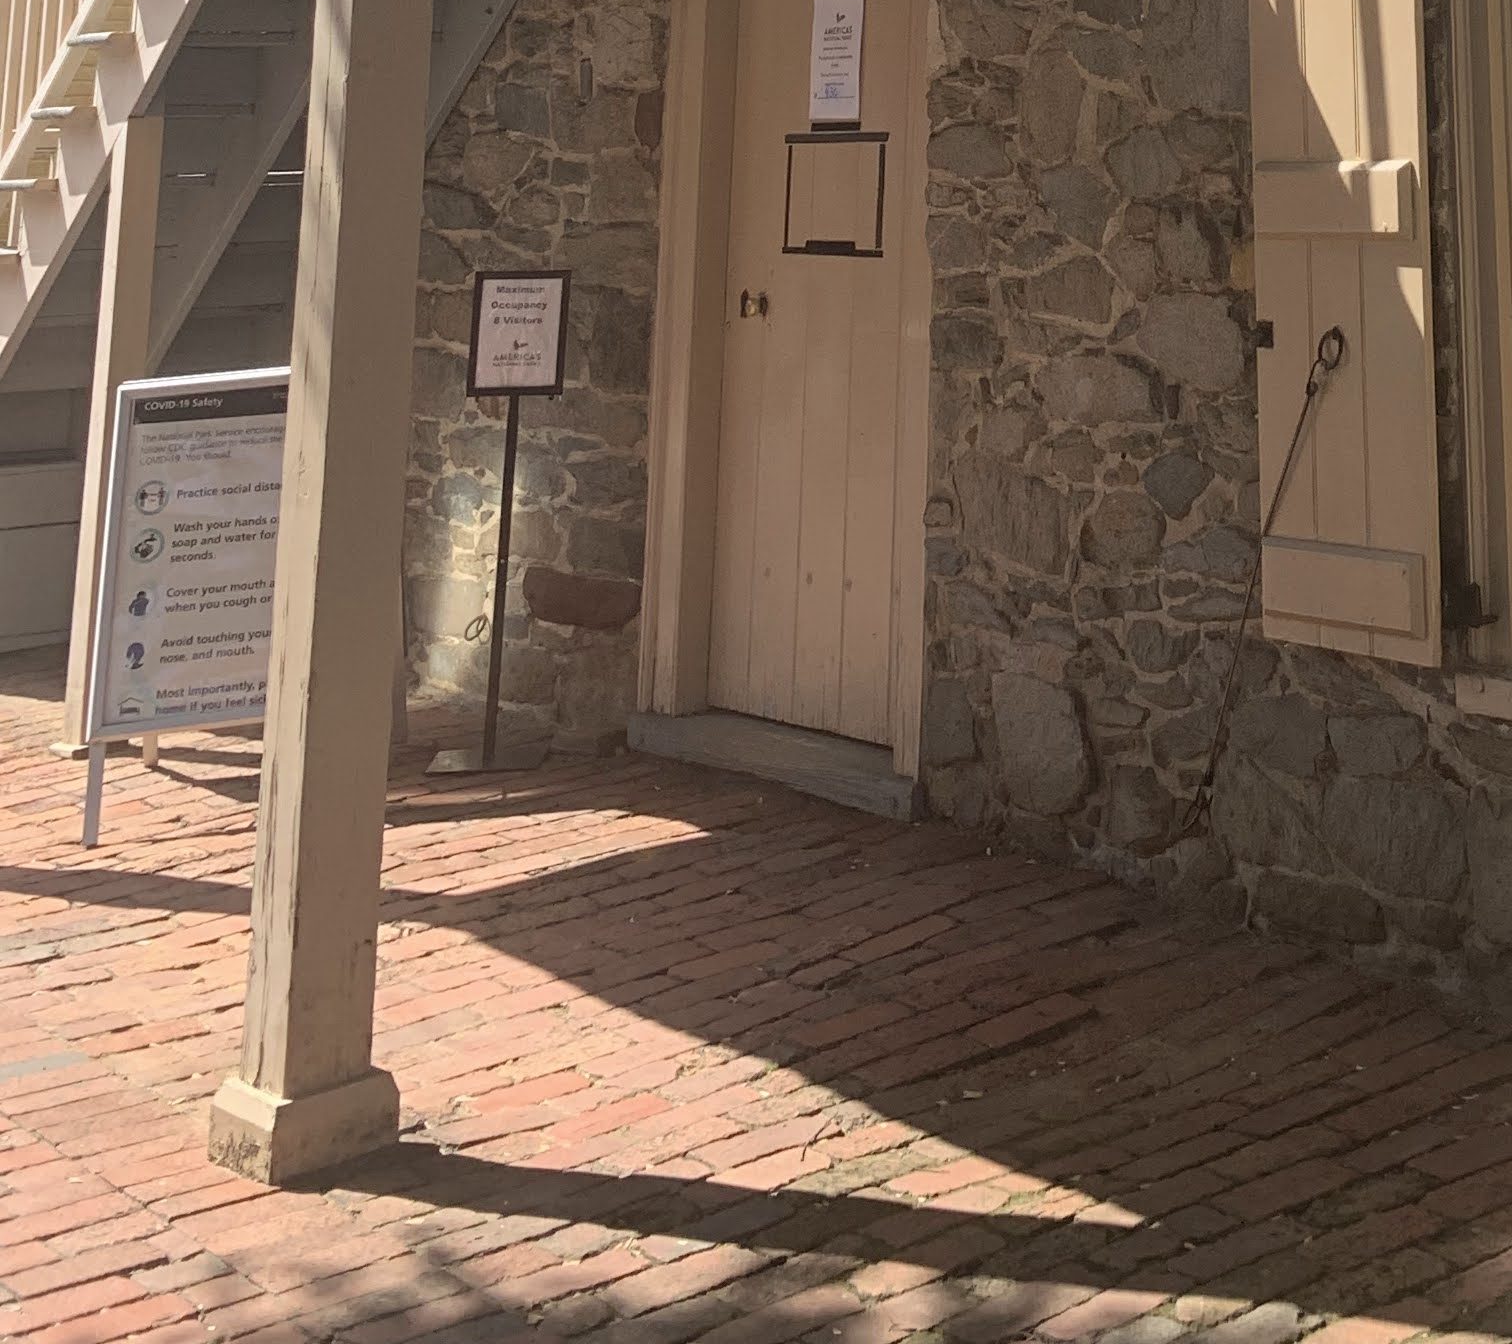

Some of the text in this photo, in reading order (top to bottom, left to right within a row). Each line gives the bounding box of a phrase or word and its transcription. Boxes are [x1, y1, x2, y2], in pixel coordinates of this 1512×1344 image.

[491, 301, 547, 310] Occupancy
[503, 316, 543, 325] Visitors
[144, 397, 223, 411] COVID-19 Safety
[177, 487, 218, 499] Practice
[221, 483, 251, 495] social
[174, 521, 203, 532] Wash
[206, 520, 231, 532] your
[234, 515, 267, 527] hands
[172, 529, 276, 548] soap and water for
[166, 587, 198, 598] Cover
[201, 584, 227, 596] your
[230, 579, 266, 592] mouth
[164, 594, 273, 613] when you cough or
[161, 635, 194, 649] Avoid
[197, 630, 245, 644] touching
[160, 652, 188, 664] nose,
[192, 648, 213, 660] and
[156, 687, 184, 699] Most
[188, 680, 255, 696] importantly,
[155, 702, 187, 714] home
[190, 701, 198, 711] if
[201, 701, 222, 714] you
[225, 696, 246, 708] feel
